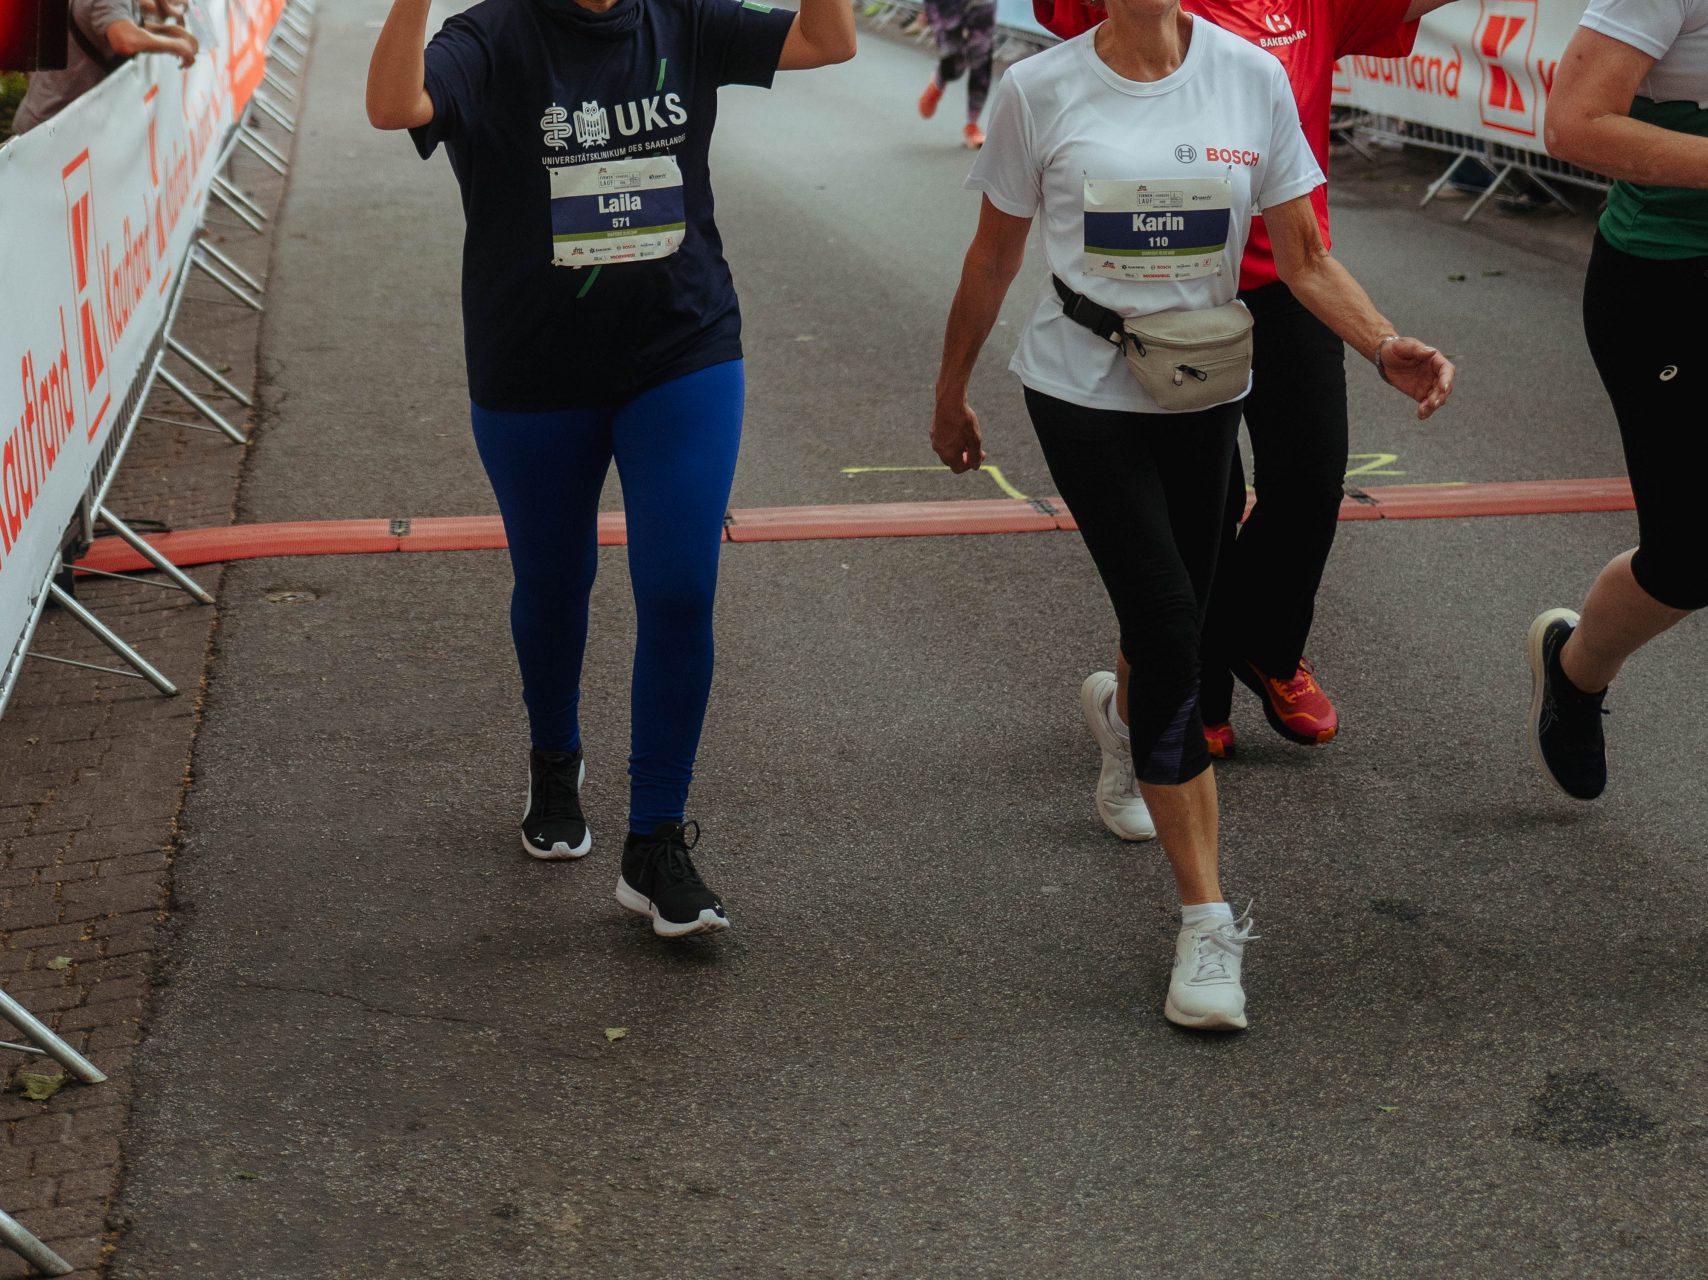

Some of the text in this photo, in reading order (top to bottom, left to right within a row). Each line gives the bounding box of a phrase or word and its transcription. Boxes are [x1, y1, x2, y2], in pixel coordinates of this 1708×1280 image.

[1260, 29, 1307, 47] BAKERMAN
[615, 93, 688, 136] UKS
[541, 147, 626, 165] UNIVERSITÄTSKLINIKUM
[628, 144, 643, 153] DES
[1206, 147, 1260, 167] BOSCH
[598, 193, 642, 214] Laila
[612, 217, 630, 228] 571
[1132, 212, 1185, 232] Karin
[1148, 236, 1169, 247] 110
[101, 190, 151, 353] Kaufland
[0, 304, 75, 570] aufland
